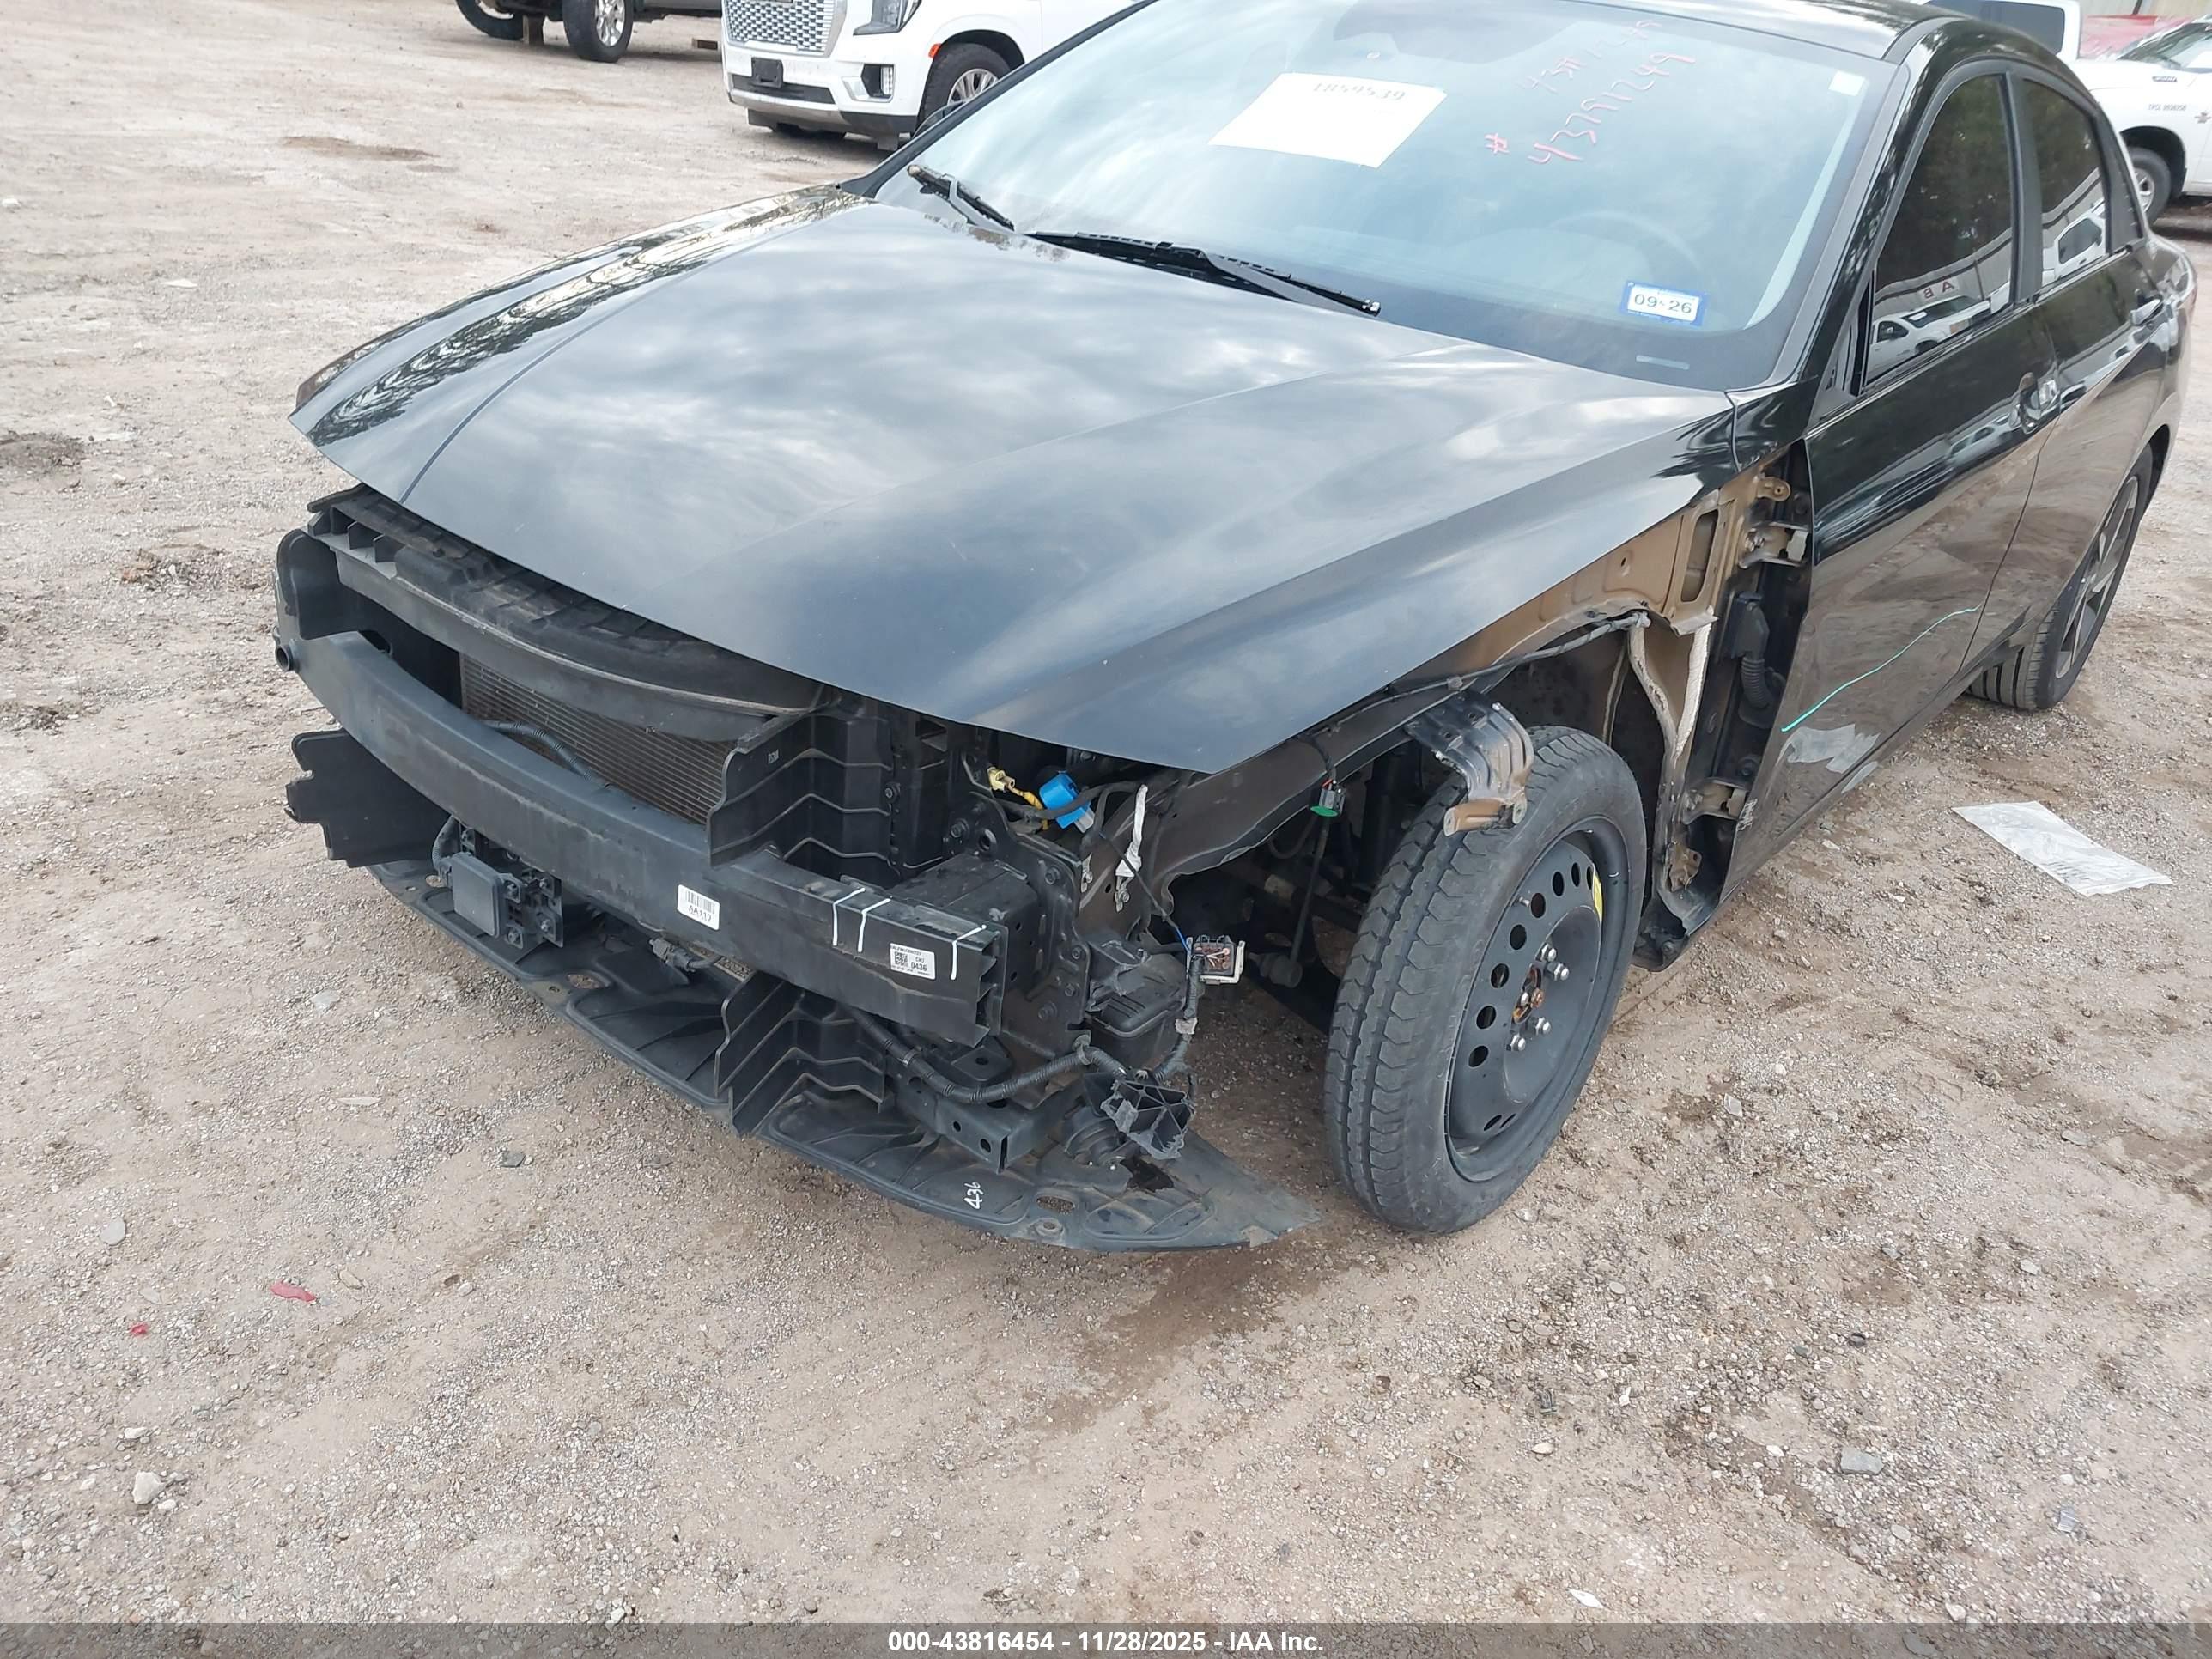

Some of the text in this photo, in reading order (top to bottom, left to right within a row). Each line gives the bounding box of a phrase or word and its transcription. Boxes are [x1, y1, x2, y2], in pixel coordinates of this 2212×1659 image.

[1485, 132, 1510, 155] #
[1634, 293, 1692, 314] 09 26
[910, 961, 927, 972] 0436
